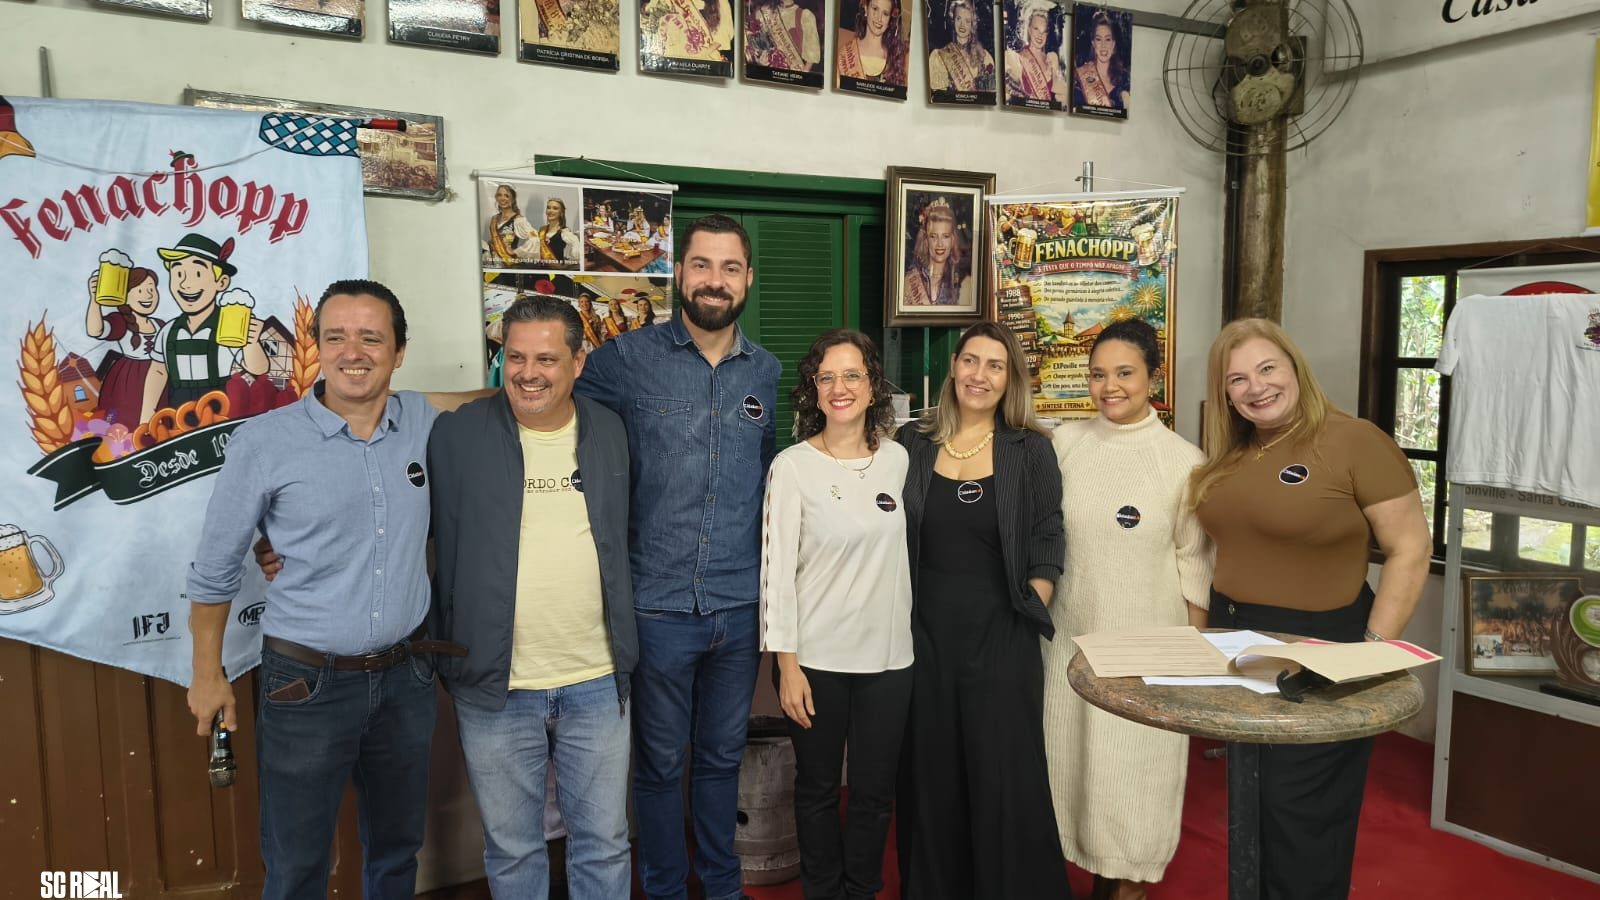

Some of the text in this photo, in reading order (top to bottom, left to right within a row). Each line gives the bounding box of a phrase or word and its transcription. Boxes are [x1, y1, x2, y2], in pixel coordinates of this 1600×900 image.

[0, 153, 310, 259] Fenachopp
[1035, 238, 1135, 264] FENACHOPP
[1006, 288, 1021, 298] 1988
[1064, 401, 1085, 409] ETERNA
[132, 449, 200, 488] Desde
[1465, 486, 1506, 499] oinville
[1518, 491, 1554, 504] Santa
